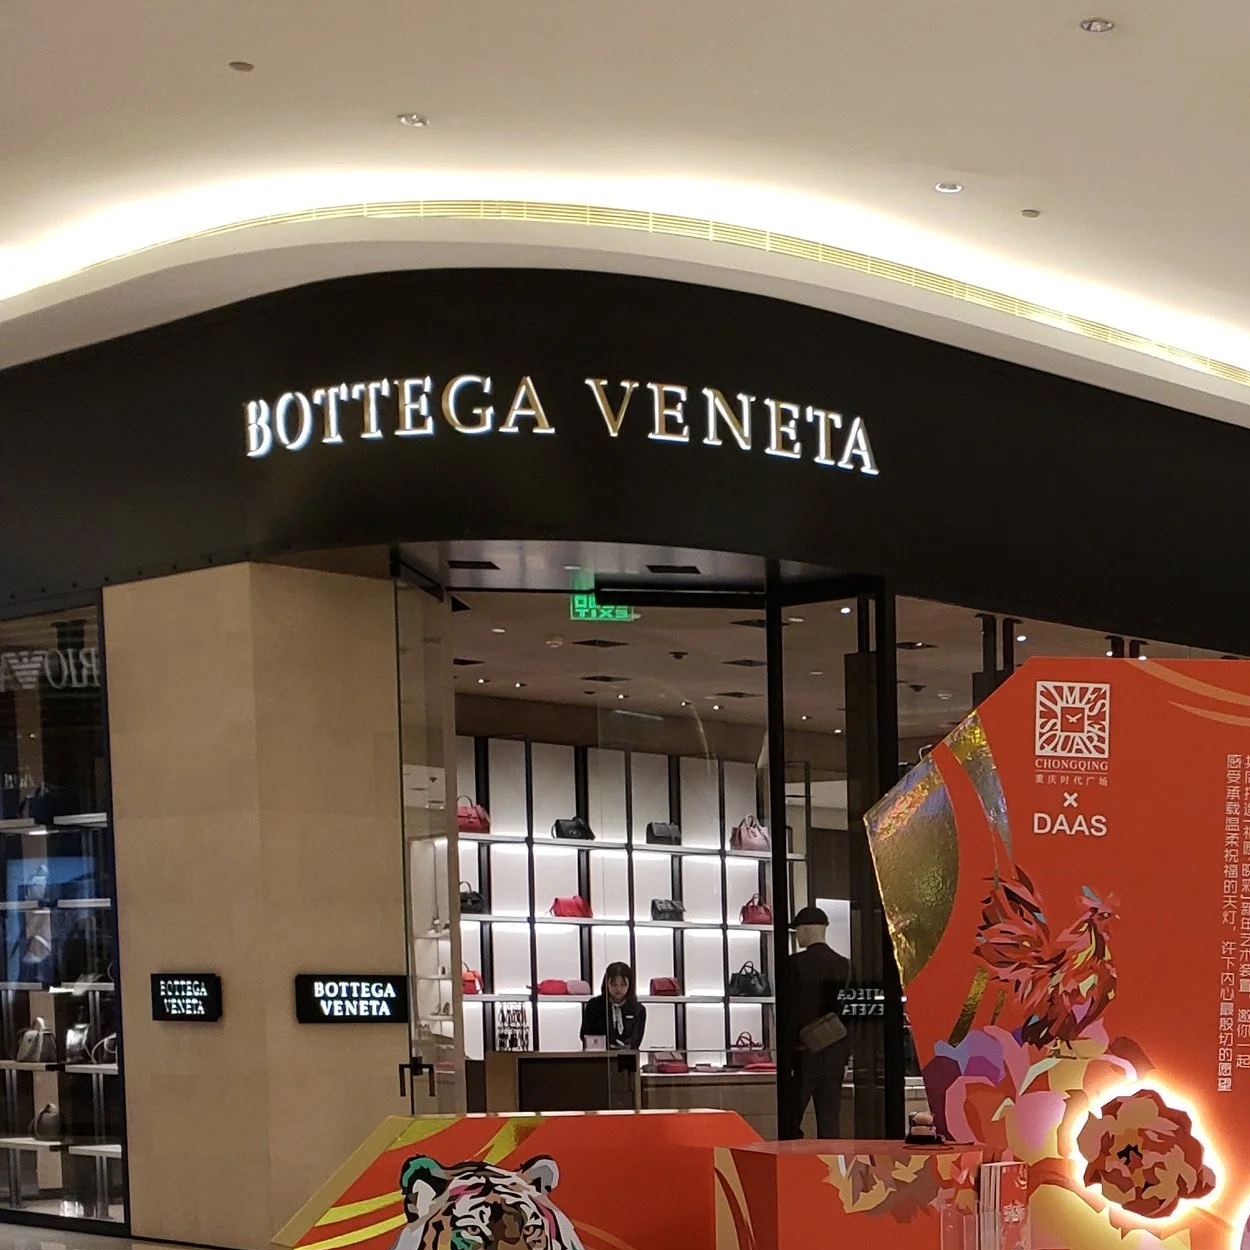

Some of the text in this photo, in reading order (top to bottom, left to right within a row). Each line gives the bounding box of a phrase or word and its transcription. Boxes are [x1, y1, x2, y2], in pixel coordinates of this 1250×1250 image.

[245, 374, 880, 476] BOTTEGA VENETA
[1034, 758, 1109, 771] CHONGQING
[1034, 773, 1109, 787] 重庆时代广场
[1033, 812, 1108, 837] DAAS
[160, 980, 208, 996] BOTTEGA
[314, 981, 396, 998] BOTTEGA
[164, 998, 205, 1015] VENETA
[320, 999, 391, 1016] VENETA
